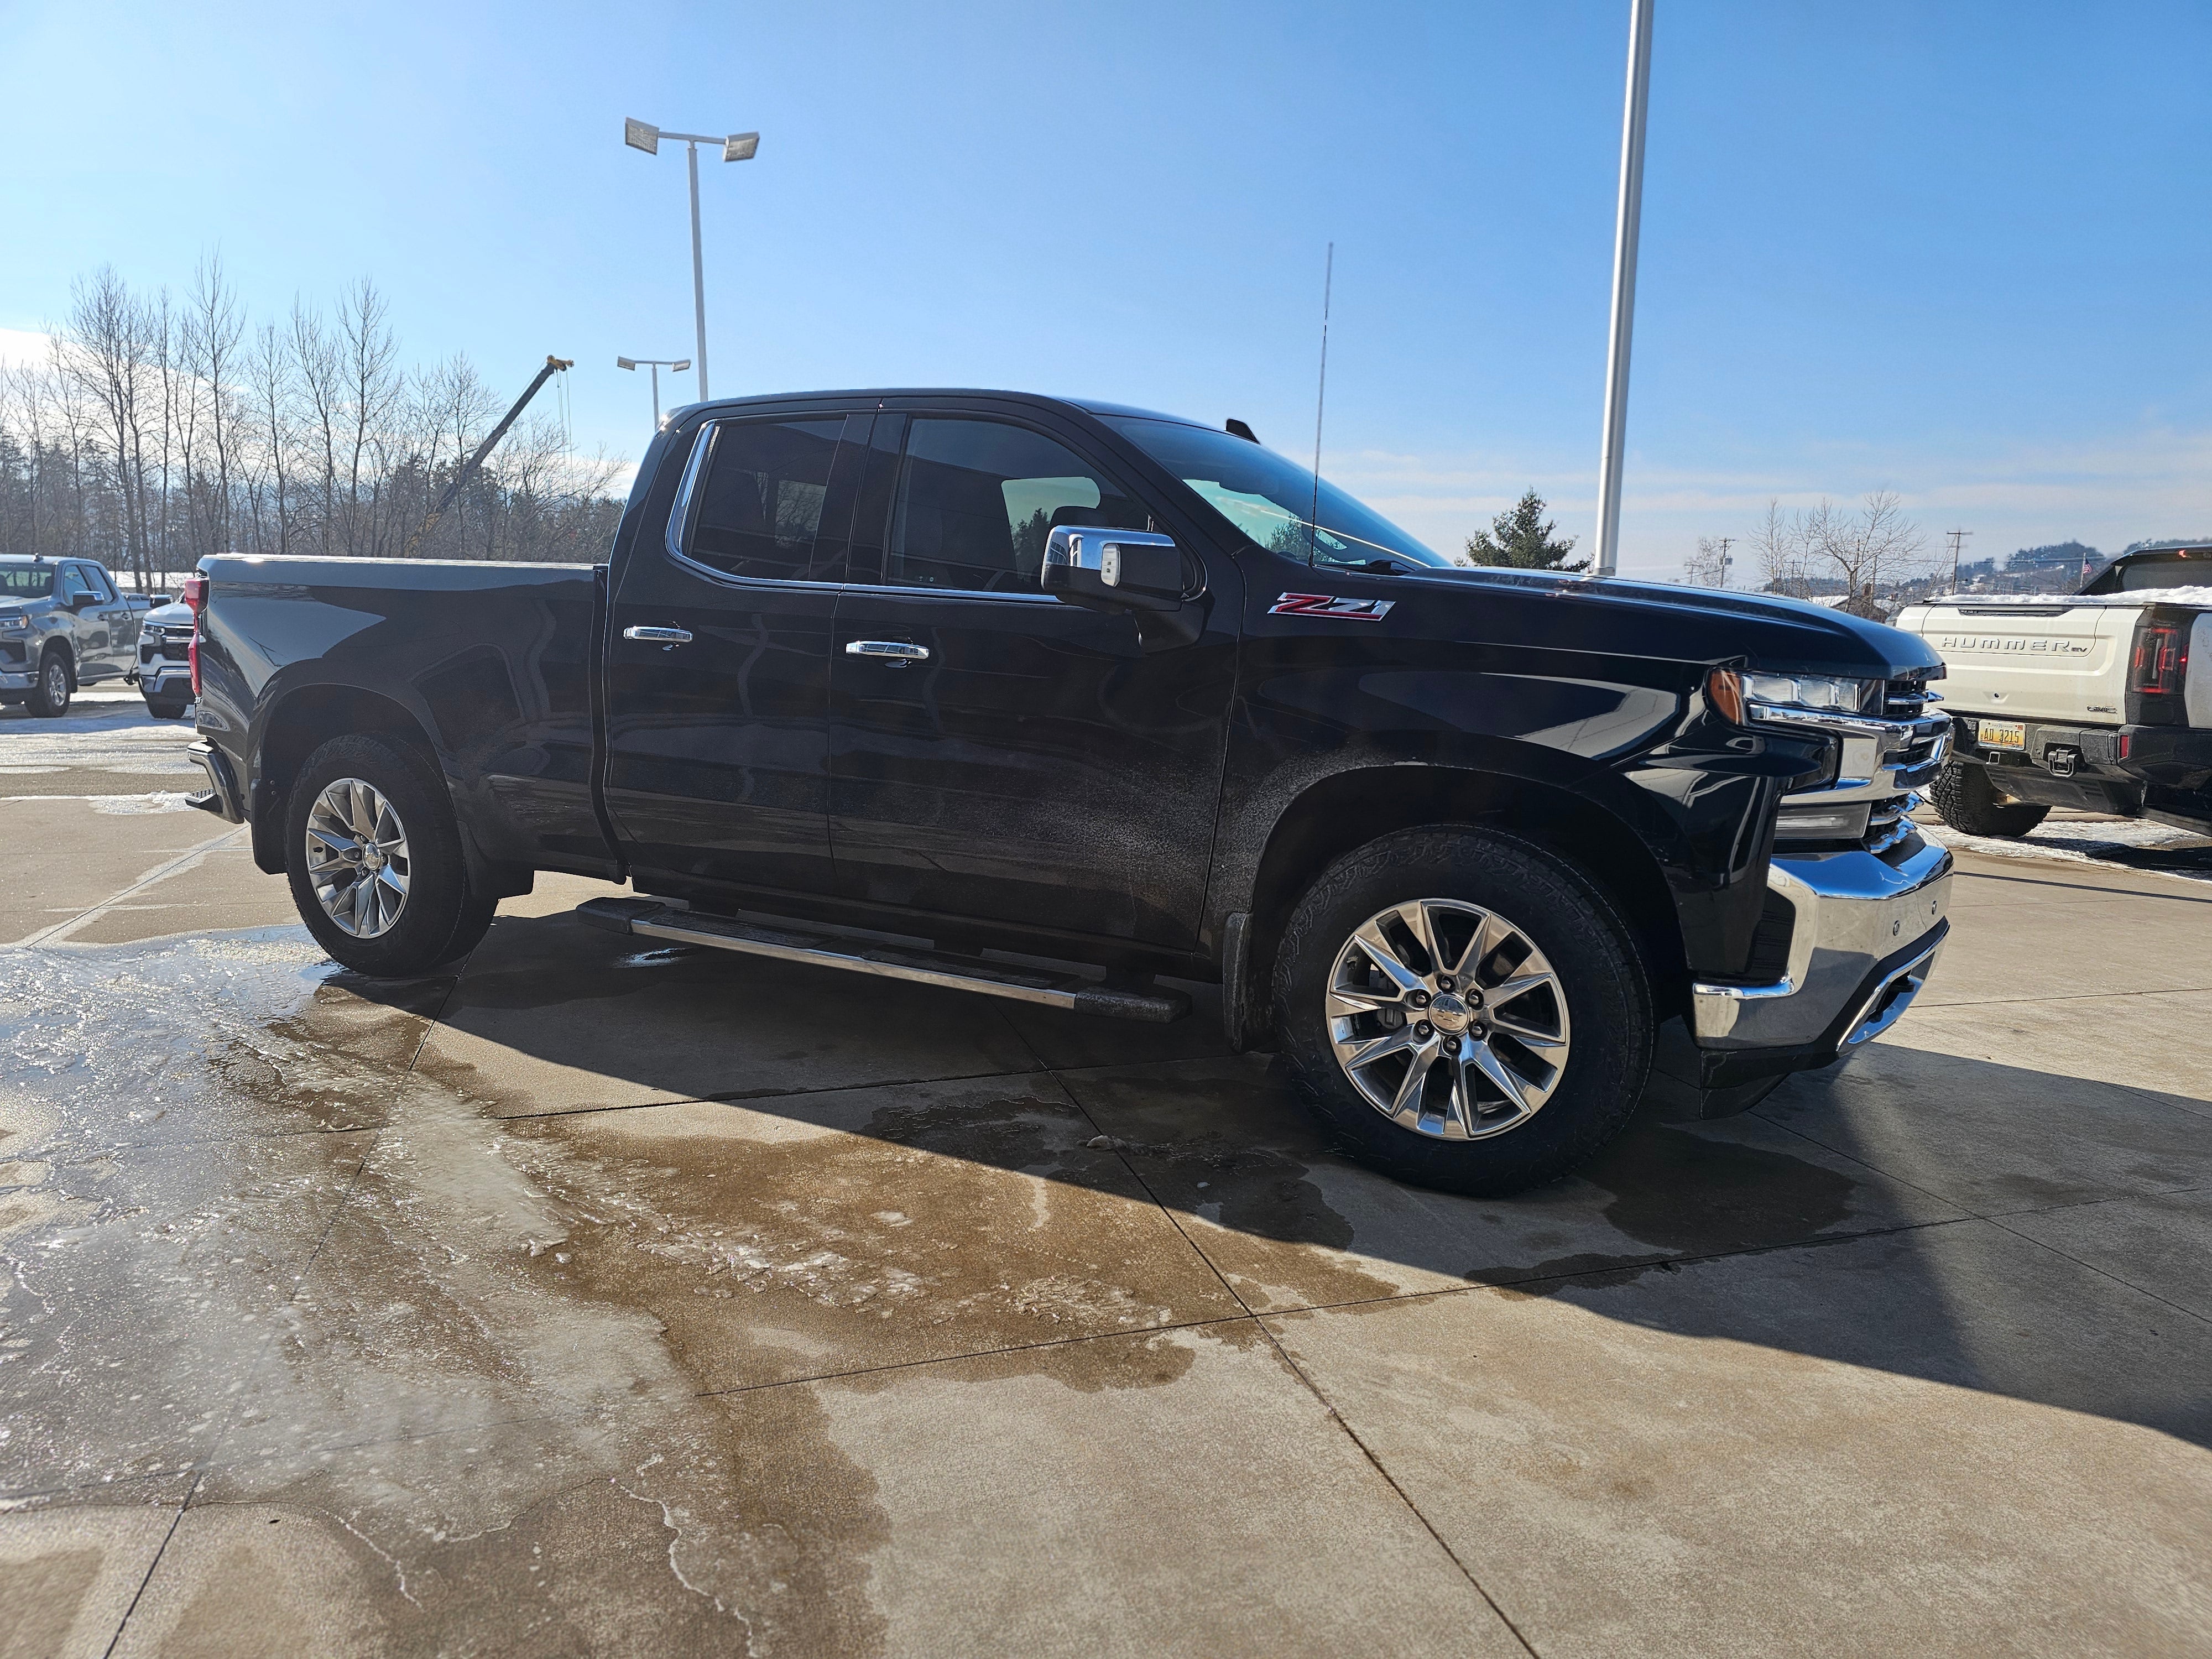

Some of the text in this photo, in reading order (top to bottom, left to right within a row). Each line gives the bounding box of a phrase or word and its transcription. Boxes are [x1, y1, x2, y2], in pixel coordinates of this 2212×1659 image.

[1267, 592, 1396, 621] Z71
[1942, 637, 2070, 651] HUMMER
[2086, 705, 2117, 714] GMC
[1999, 729, 2020, 743] 3215
